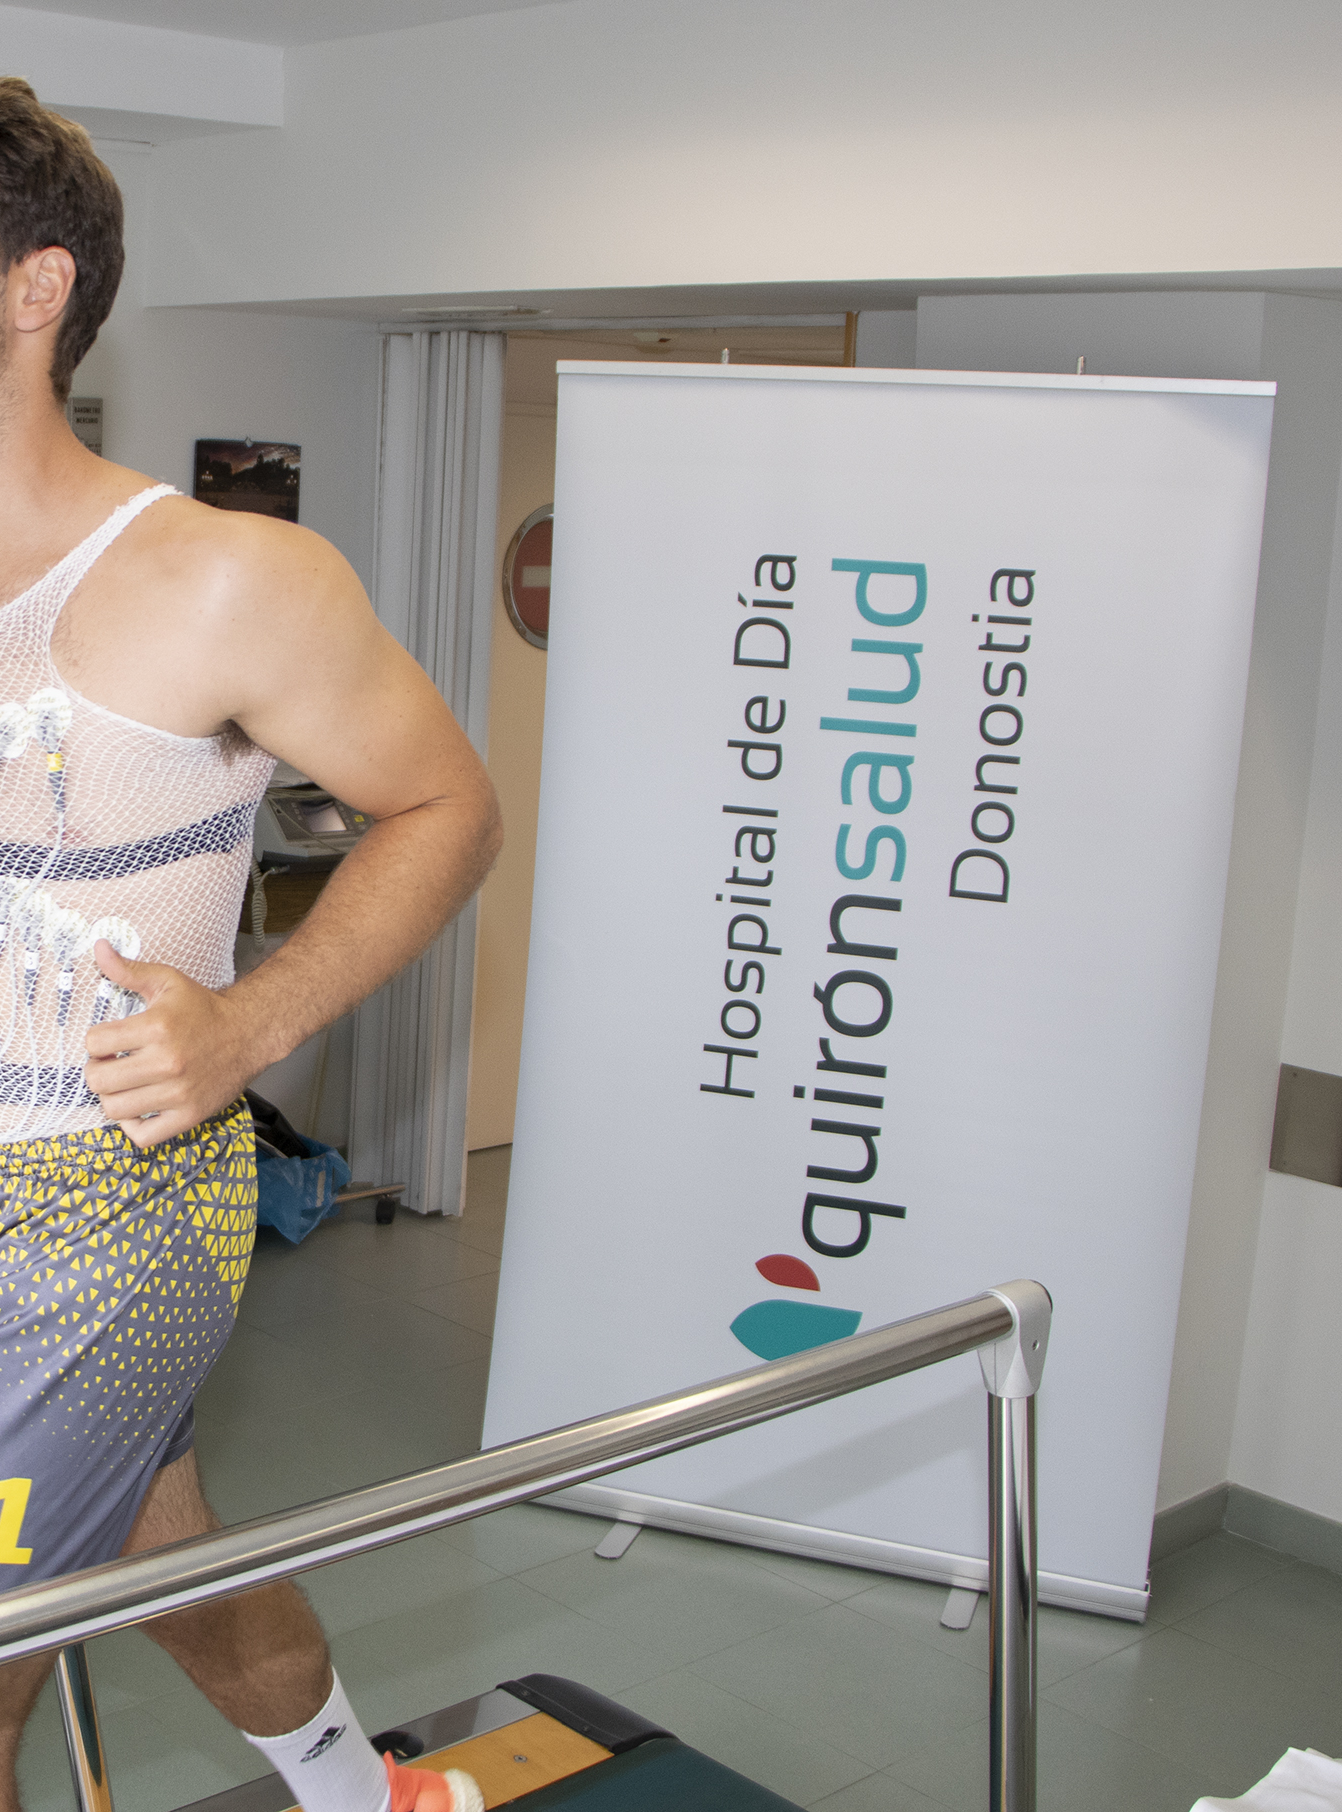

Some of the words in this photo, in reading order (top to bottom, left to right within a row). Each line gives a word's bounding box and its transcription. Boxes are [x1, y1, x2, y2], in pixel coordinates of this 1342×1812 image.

[733, 554, 798, 670] Día
[728, 696, 786, 781] de
[949, 568, 1036, 904] Donostia
[700, 805, 782, 1099] Hospital
[792, 557, 928, 1260] quirónsalud
[299, 1723, 347, 1764] adidas
